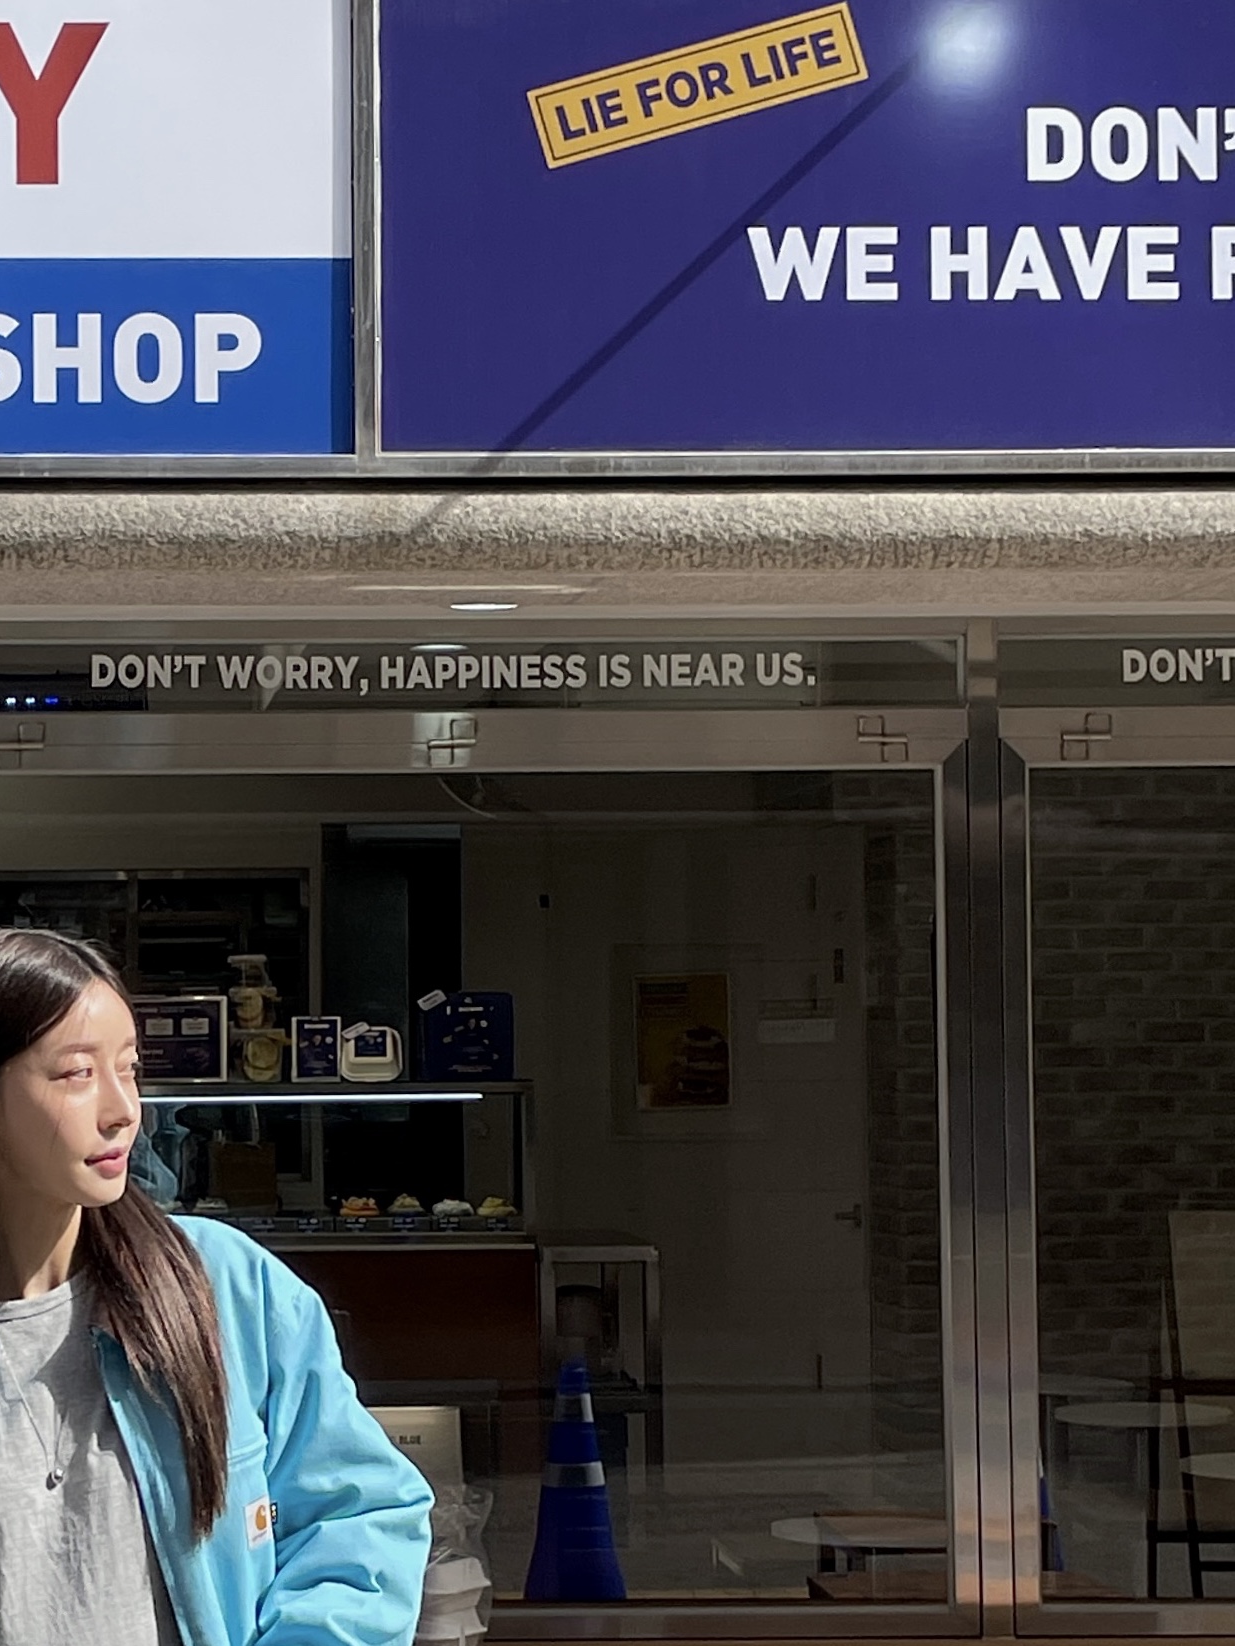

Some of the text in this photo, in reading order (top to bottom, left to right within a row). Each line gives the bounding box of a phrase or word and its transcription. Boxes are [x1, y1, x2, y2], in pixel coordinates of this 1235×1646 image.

[555, 28, 842, 141] LIE FOR LIFE
[746, 226, 899, 301] WE
[930, 226, 1180, 301] HAVE
[90, 652, 816, 696] DON'T WORRY, HAPPINESS IS NEAR US.
[1122, 648, 1235, 682] DON'T
